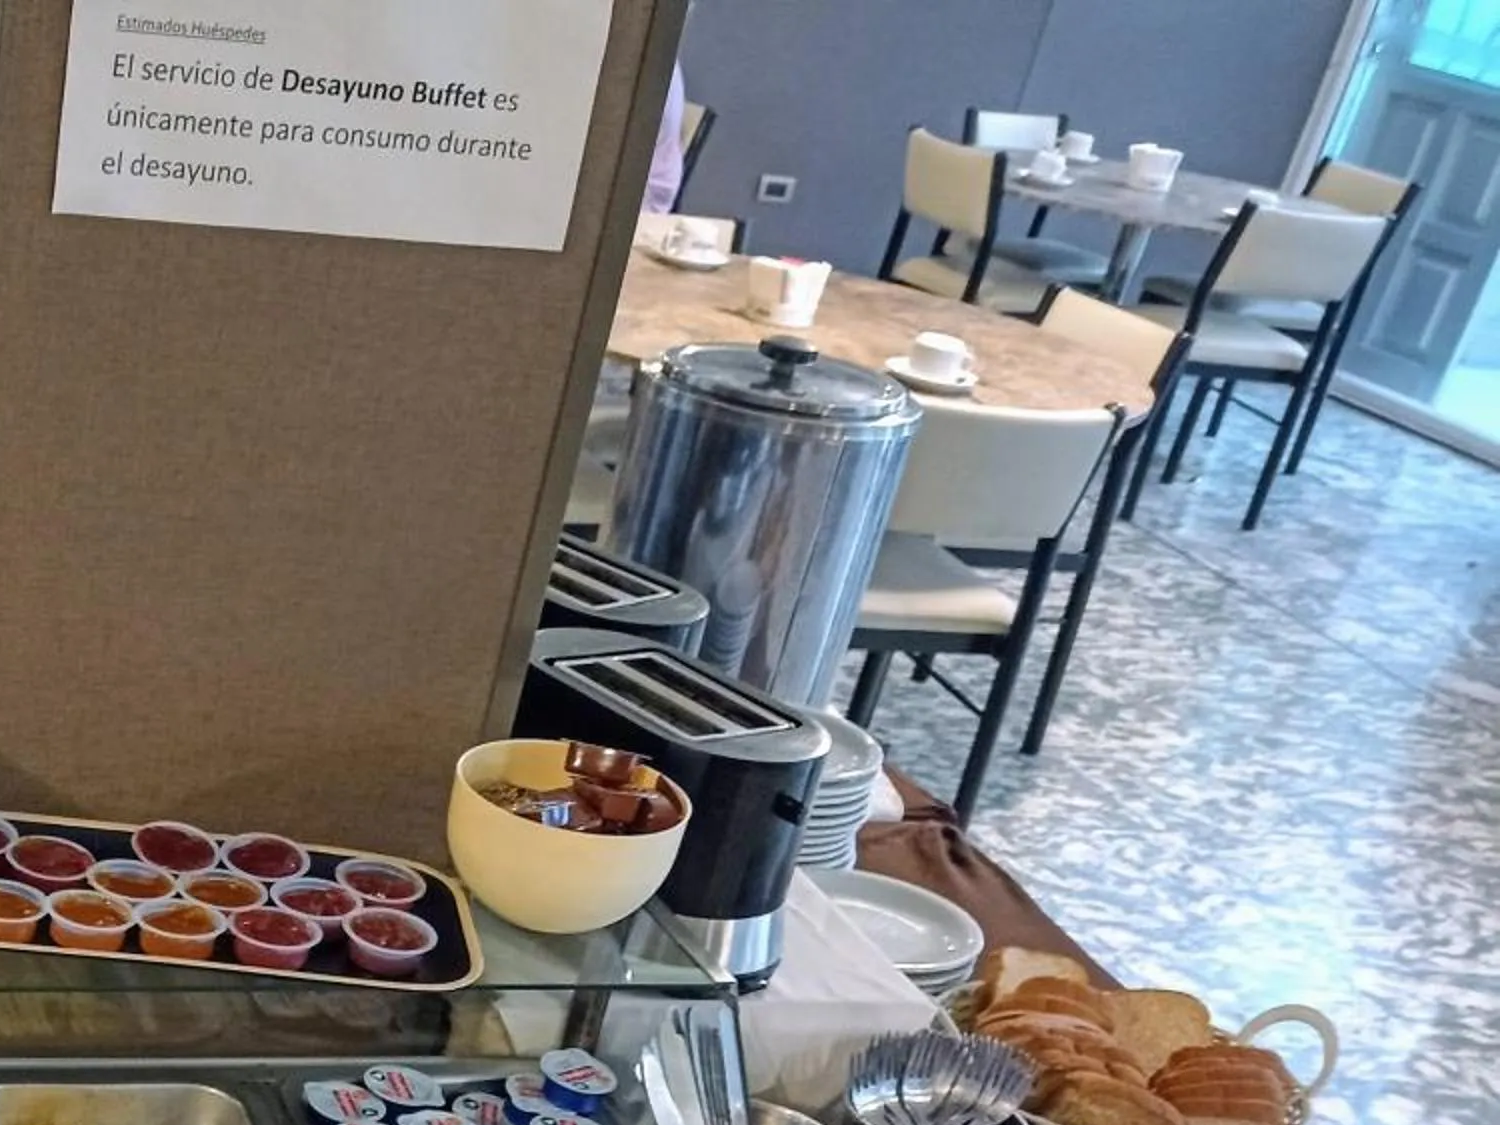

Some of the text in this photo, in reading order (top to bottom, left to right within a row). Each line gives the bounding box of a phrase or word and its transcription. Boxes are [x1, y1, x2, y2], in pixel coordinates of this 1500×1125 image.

[116, 14, 266, 44] Estimados Huéspedes
[112, 53, 519, 112] El servicio de Desayuno Buffet es
[106, 101, 532, 161] únicamente para consumo durante
[101, 151, 253, 187] el desayuno.
